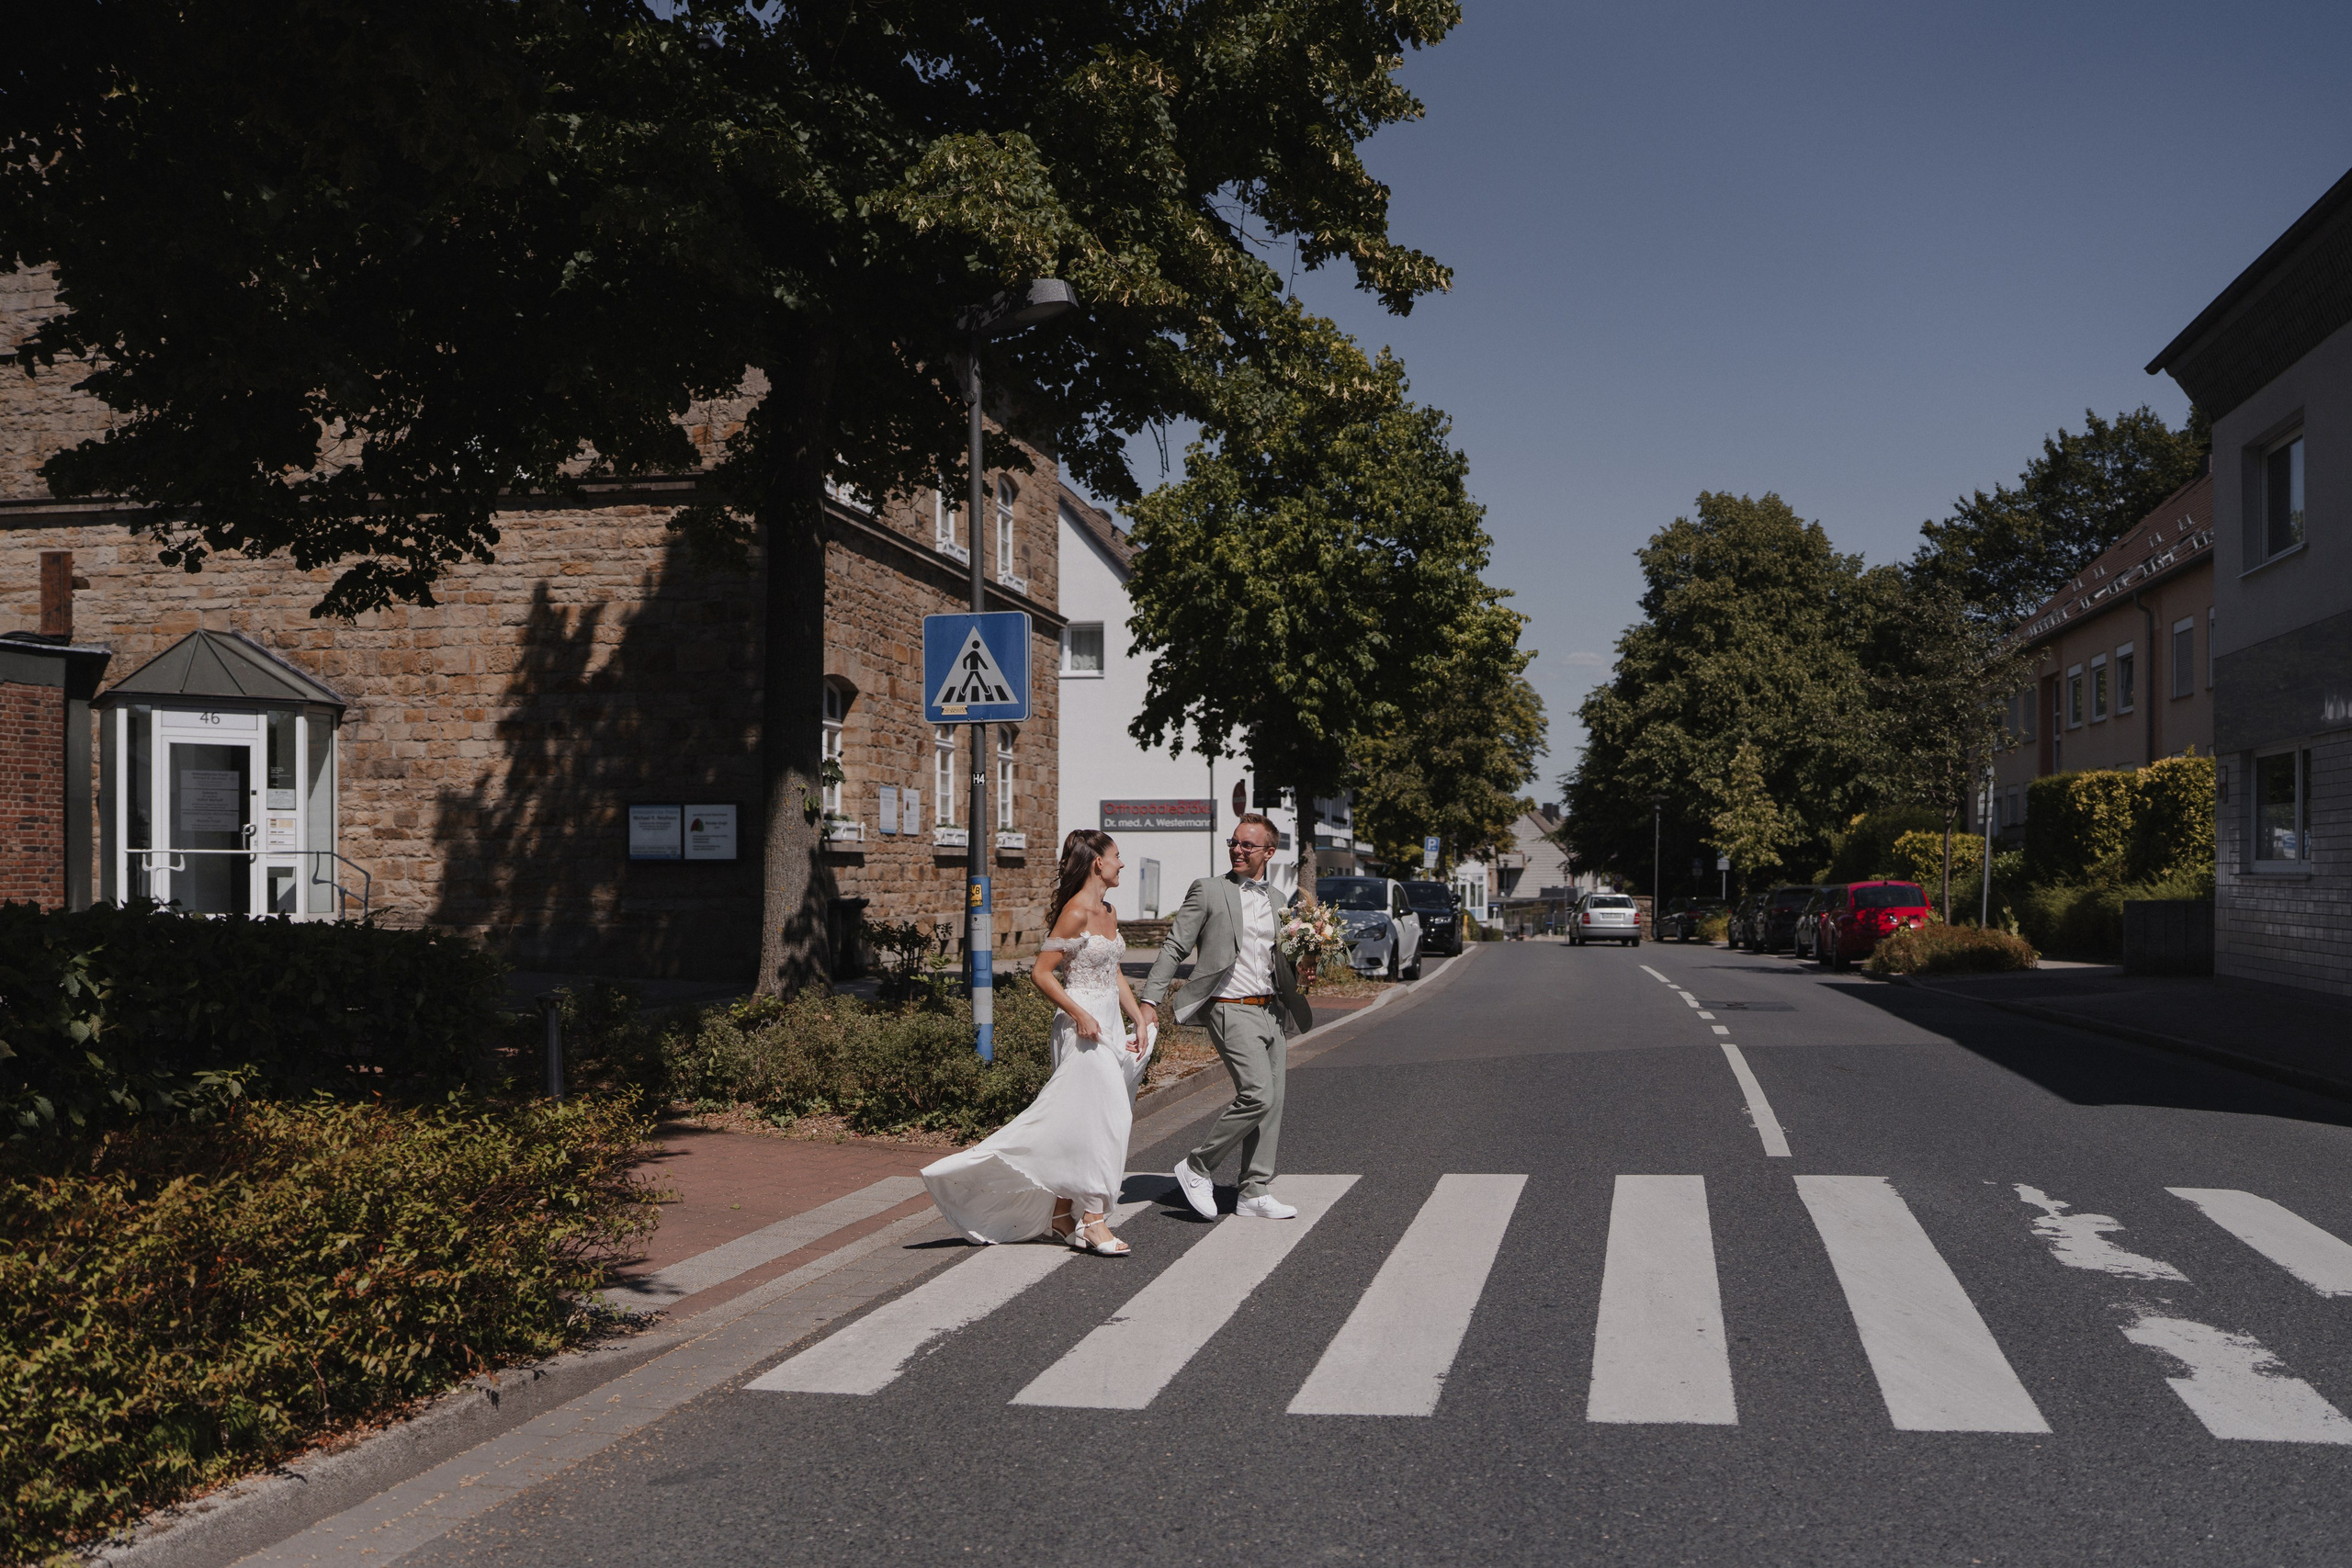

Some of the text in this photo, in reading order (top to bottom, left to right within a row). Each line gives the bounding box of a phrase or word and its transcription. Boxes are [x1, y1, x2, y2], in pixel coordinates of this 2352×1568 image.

[199, 711, 220, 725] 46
[973, 773, 985, 784] H4
[1104, 818, 1116, 827] Dr.
[1118, 818, 1142, 827] med.
[1144, 818, 1154, 827] A.
[1428, 839, 1437, 851] P
